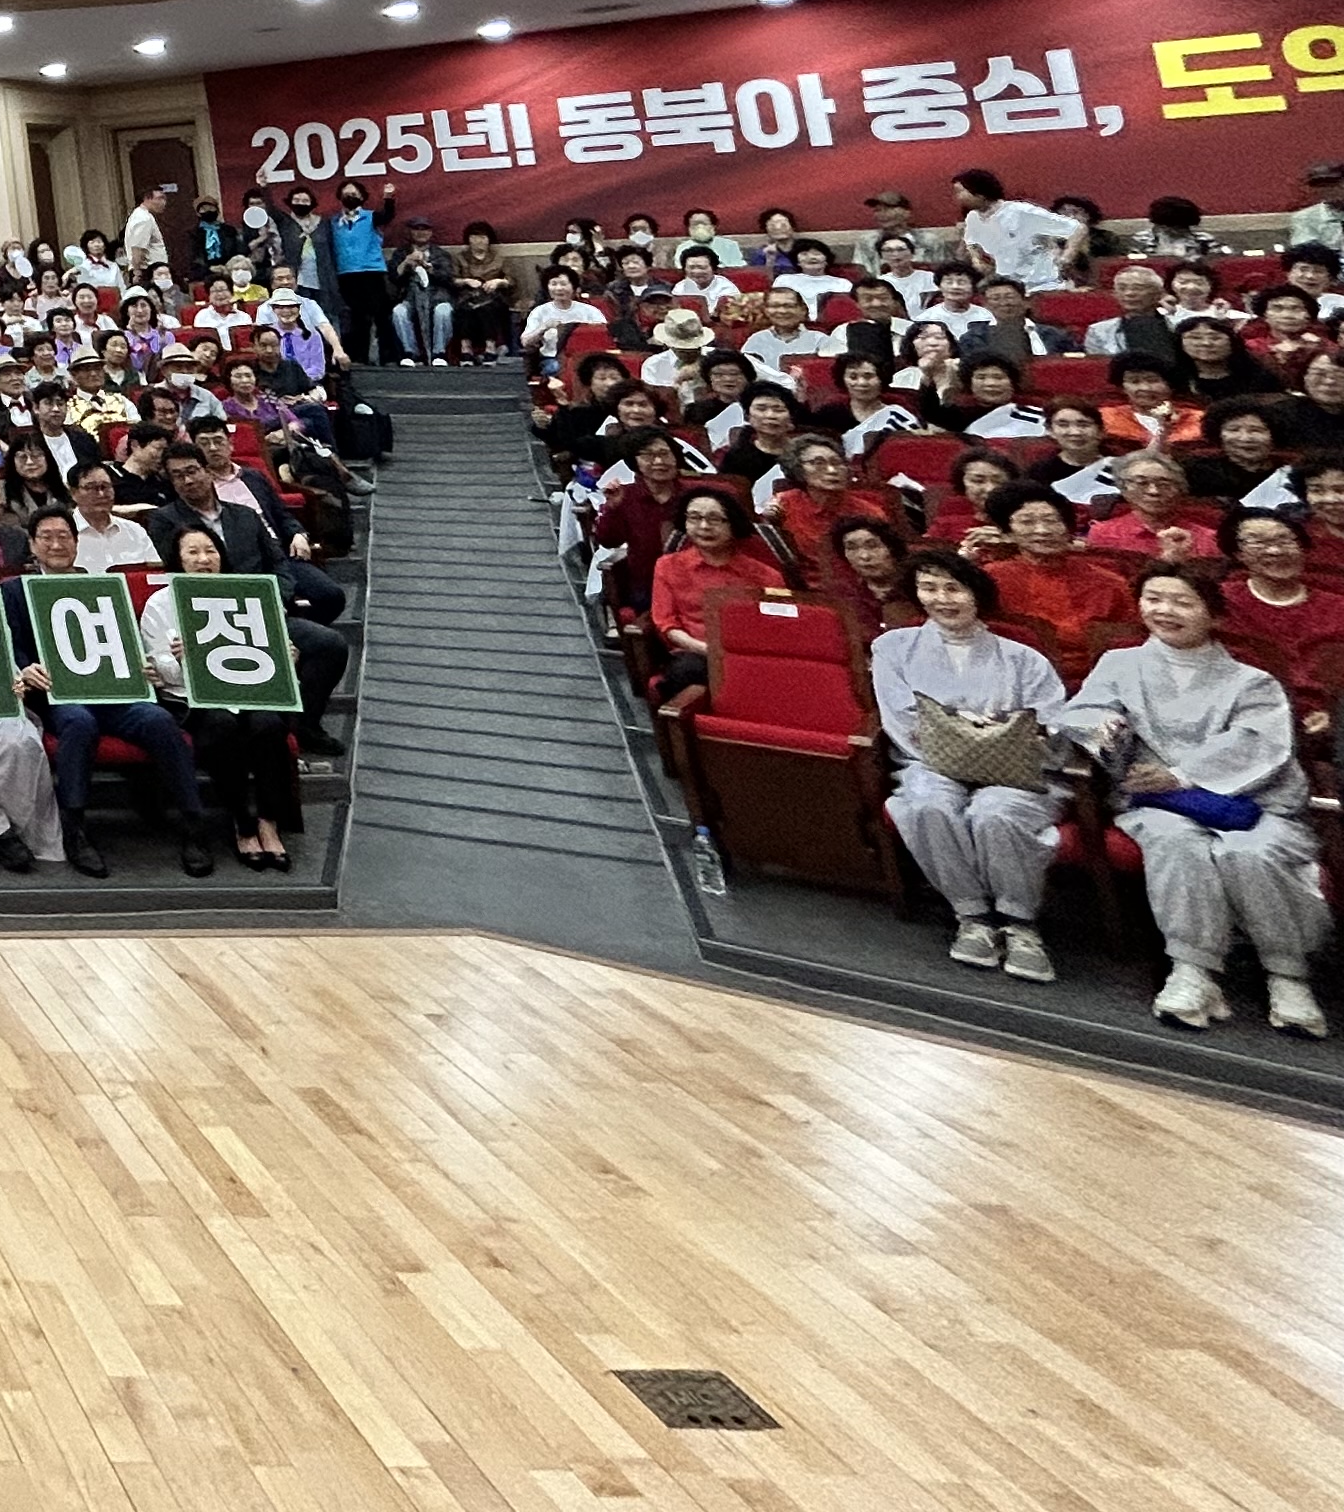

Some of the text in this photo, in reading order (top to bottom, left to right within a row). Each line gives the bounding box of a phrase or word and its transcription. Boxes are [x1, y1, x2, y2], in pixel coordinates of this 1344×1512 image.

[251, 101, 537, 184] 2025년!
[557, 73, 842, 165] 동북아
[860, 47, 1126, 142] 중심,
